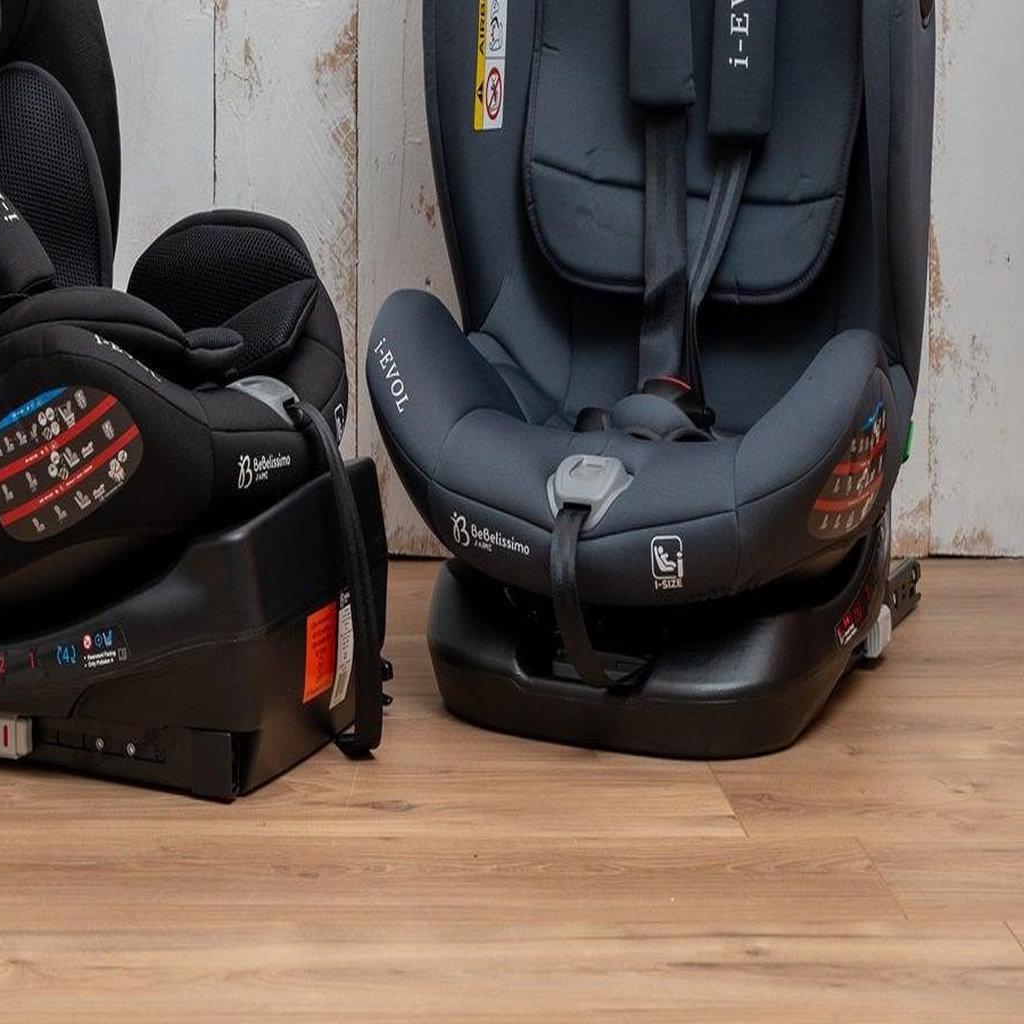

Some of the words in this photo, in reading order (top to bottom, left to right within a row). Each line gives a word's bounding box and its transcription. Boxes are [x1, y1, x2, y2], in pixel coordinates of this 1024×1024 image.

[374, 337, 409, 413] i-EVOL
[253, 453, 291, 472] BeBelissimo
[471, 524, 530, 556] BeBelissimo
